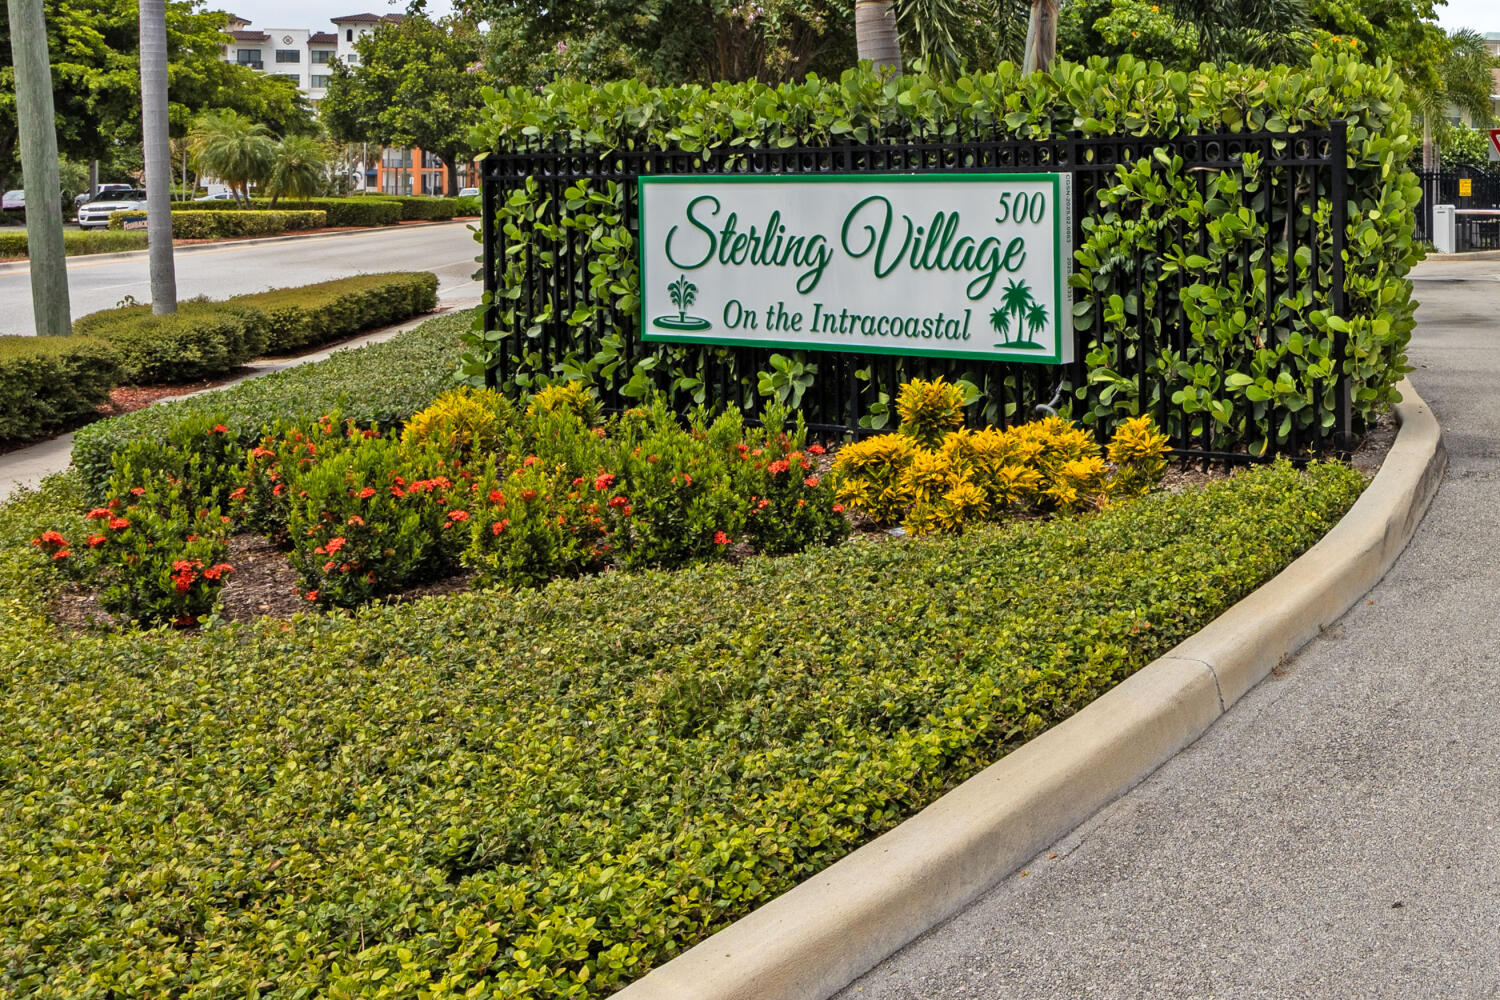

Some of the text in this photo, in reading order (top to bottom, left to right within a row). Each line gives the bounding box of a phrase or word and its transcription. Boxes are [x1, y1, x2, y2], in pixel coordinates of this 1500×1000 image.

[995, 191, 1046, 225] 500
[664, 195, 1027, 301] Sterling Village
[723, 299, 972, 341] On the Intracoastal
